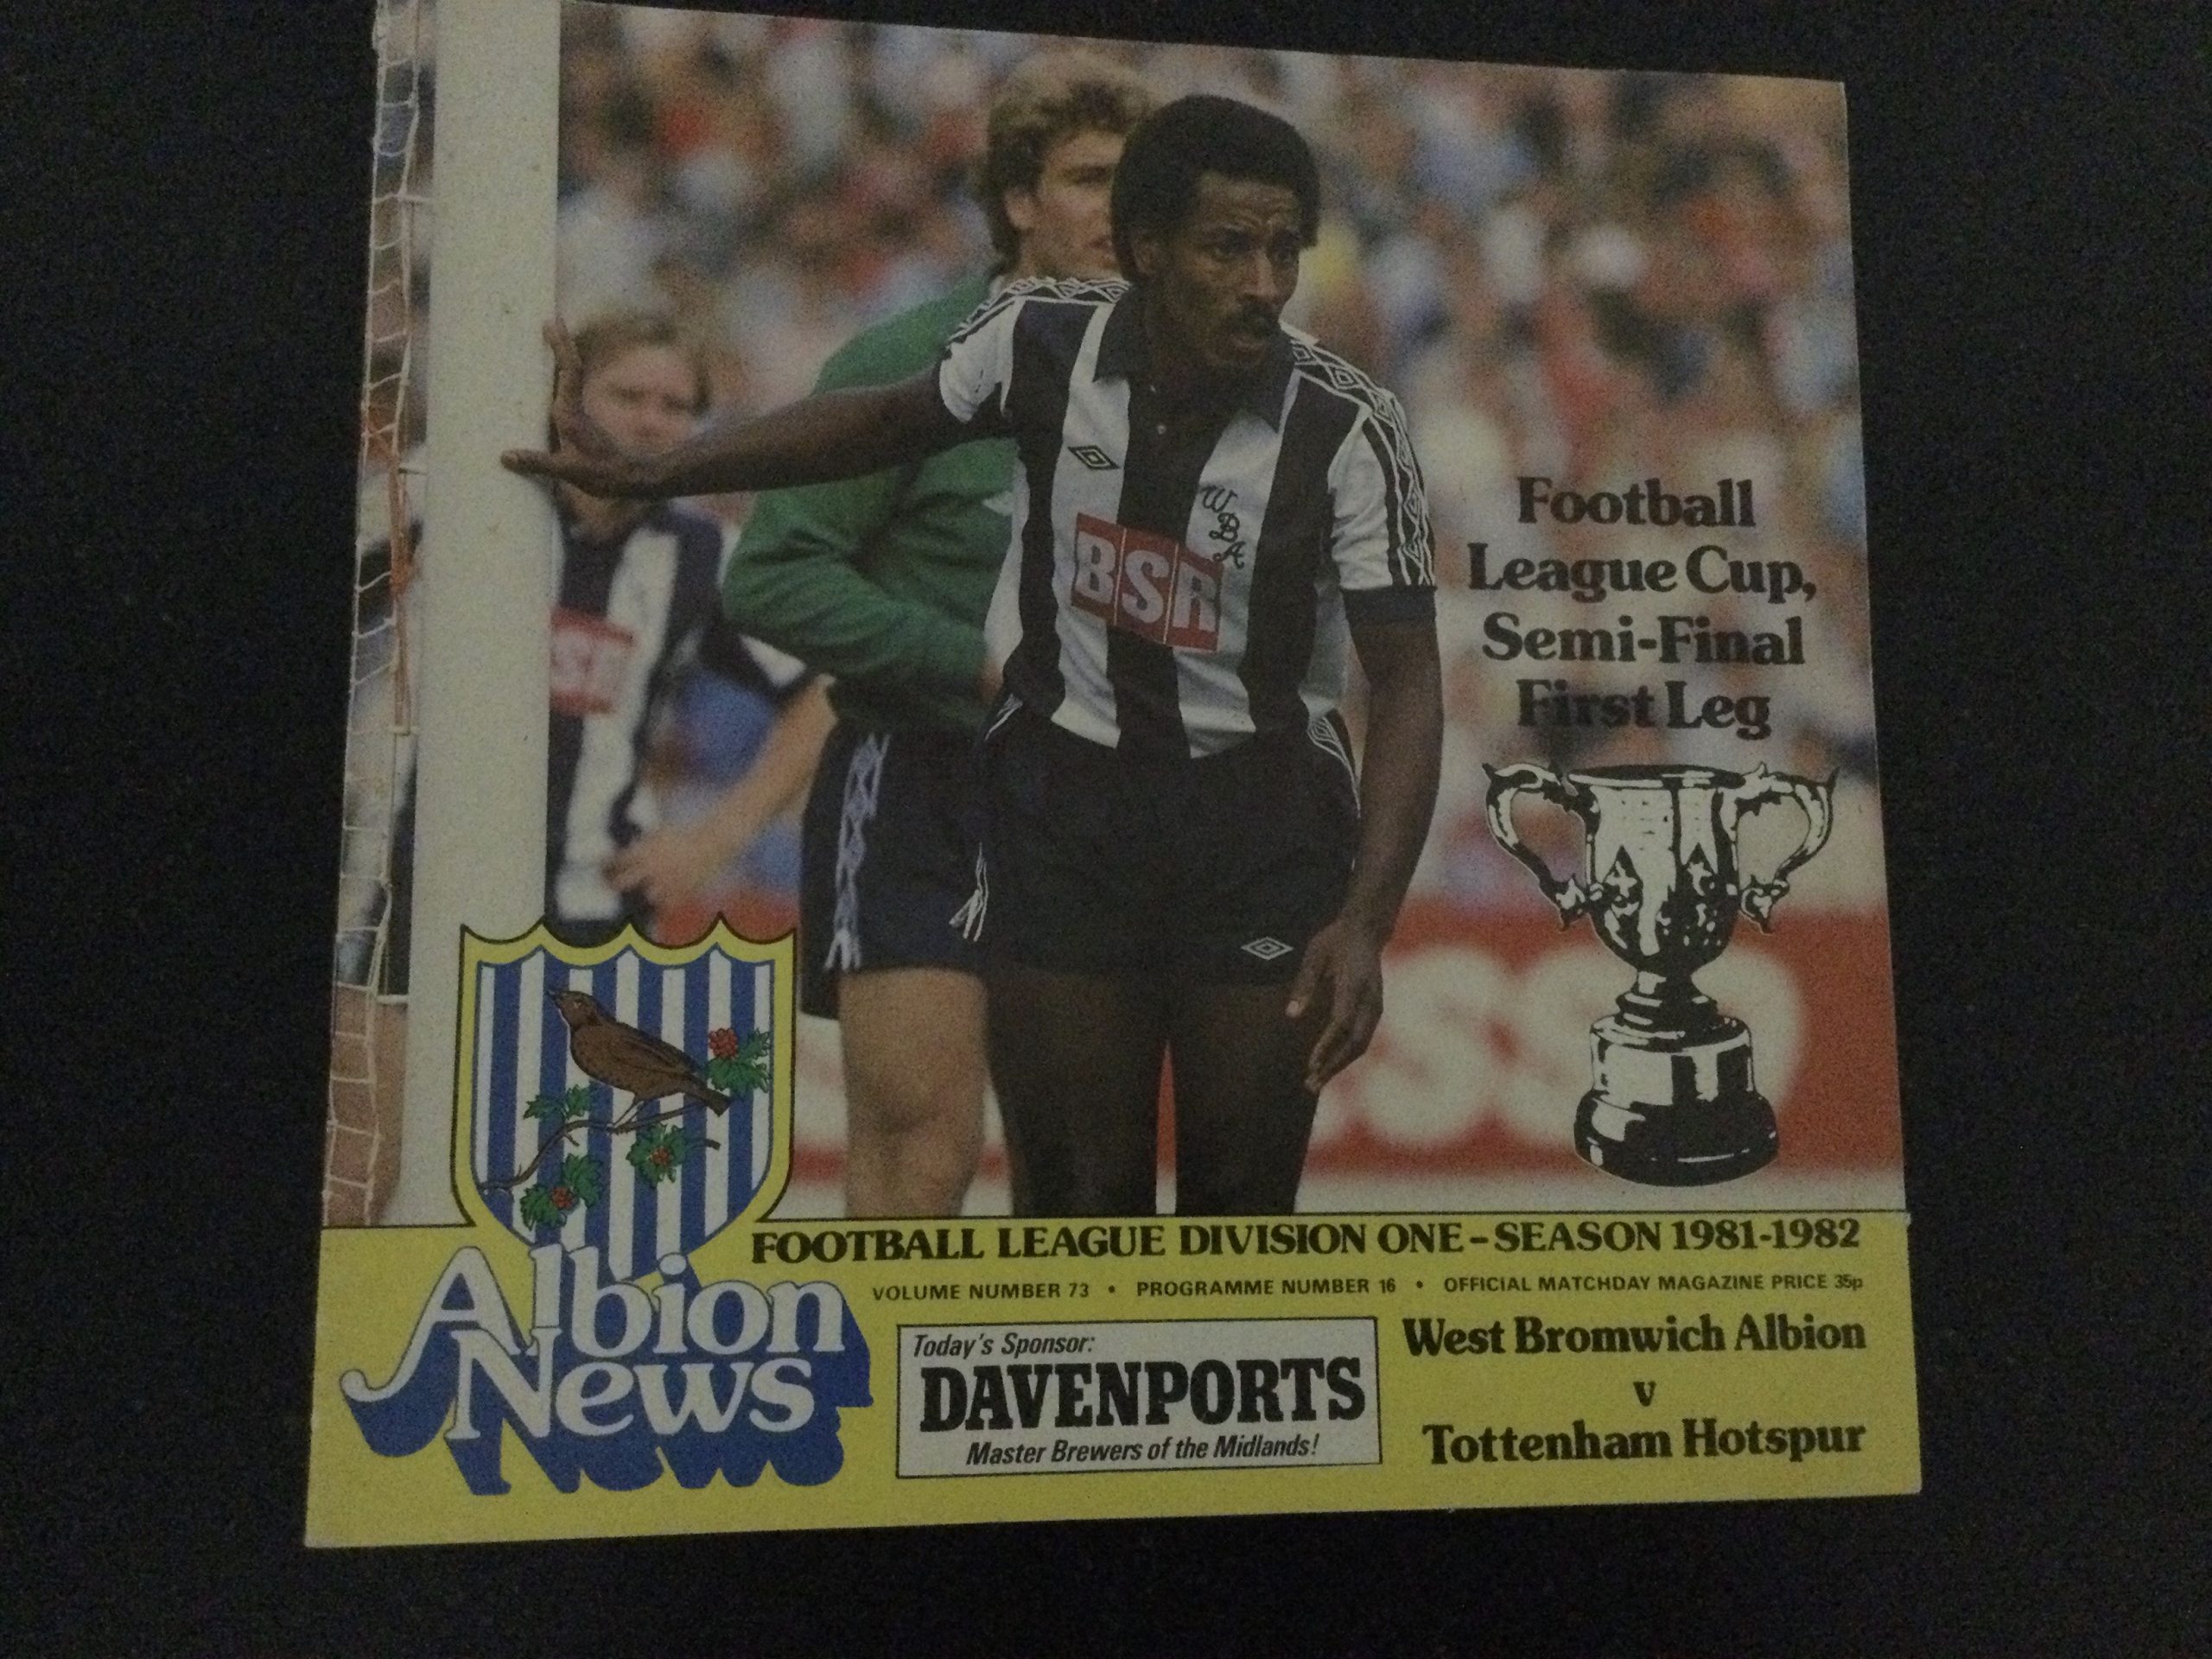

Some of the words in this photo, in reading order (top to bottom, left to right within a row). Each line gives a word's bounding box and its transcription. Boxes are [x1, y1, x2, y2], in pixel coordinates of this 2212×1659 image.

[1517, 476, 1755, 527] Football
[1075, 531, 1217, 632] BSR
[1468, 543, 1677, 603] League
[1686, 545, 1815, 603] Cup,
[1482, 612, 1805, 664] Semi-Final
[1516, 679, 1655, 728] First
[1665, 681, 1771, 740] Leg
[752, 1228, 983, 1264] FOOTBALL
[997, 1224, 1165, 1259] LEAGUE
[1179, 1222, 1366, 1257] DIVISION
[1672, 1218, 1860, 1250] 1981-1982
[872, 1284, 961, 1301] VOLUME
[969, 1282, 1060, 1300] NUMBER
[1069, 1282, 1090, 1298] 73
[1135, 1280, 1274, 1298] PROGRAMME
[1281, 1279, 1370, 1295] NUMBER
[1379, 1279, 1395, 1294] 16
[1445, 1277, 1531, 1294] OFFICIAL
[1539, 1276, 1650, 1293] MATCHDAY
[1658, 1274, 1764, 1291] MAGAZINE
[1770, 1274, 1827, 1290] PRICE
[1834, 1274, 1864, 1291] 35p
[340, 1243, 846, 1402] Albion
[1001, 1332, 1095, 1358] Sponsor:
[1402, 1317, 1505, 1356] West
[1514, 1313, 1726, 1354] Bromwich
[1734, 1313, 1866, 1351] Albion
[444, 1327, 815, 1440] News
[920, 1357, 1365, 1432] DAVENPORTS
[1634, 1381, 1656, 1407] v
[965, 1440, 1044, 1466] Master
[1051, 1439, 1141, 1464] Brewers
[1147, 1437, 1173, 1460] of
[1175, 1436, 1209, 1459] the
[1214, 1433, 1319, 1459] Midlands!
[1422, 1421, 1672, 1465] Tottenham
[1682, 1418, 1866, 1462] Hotspur
